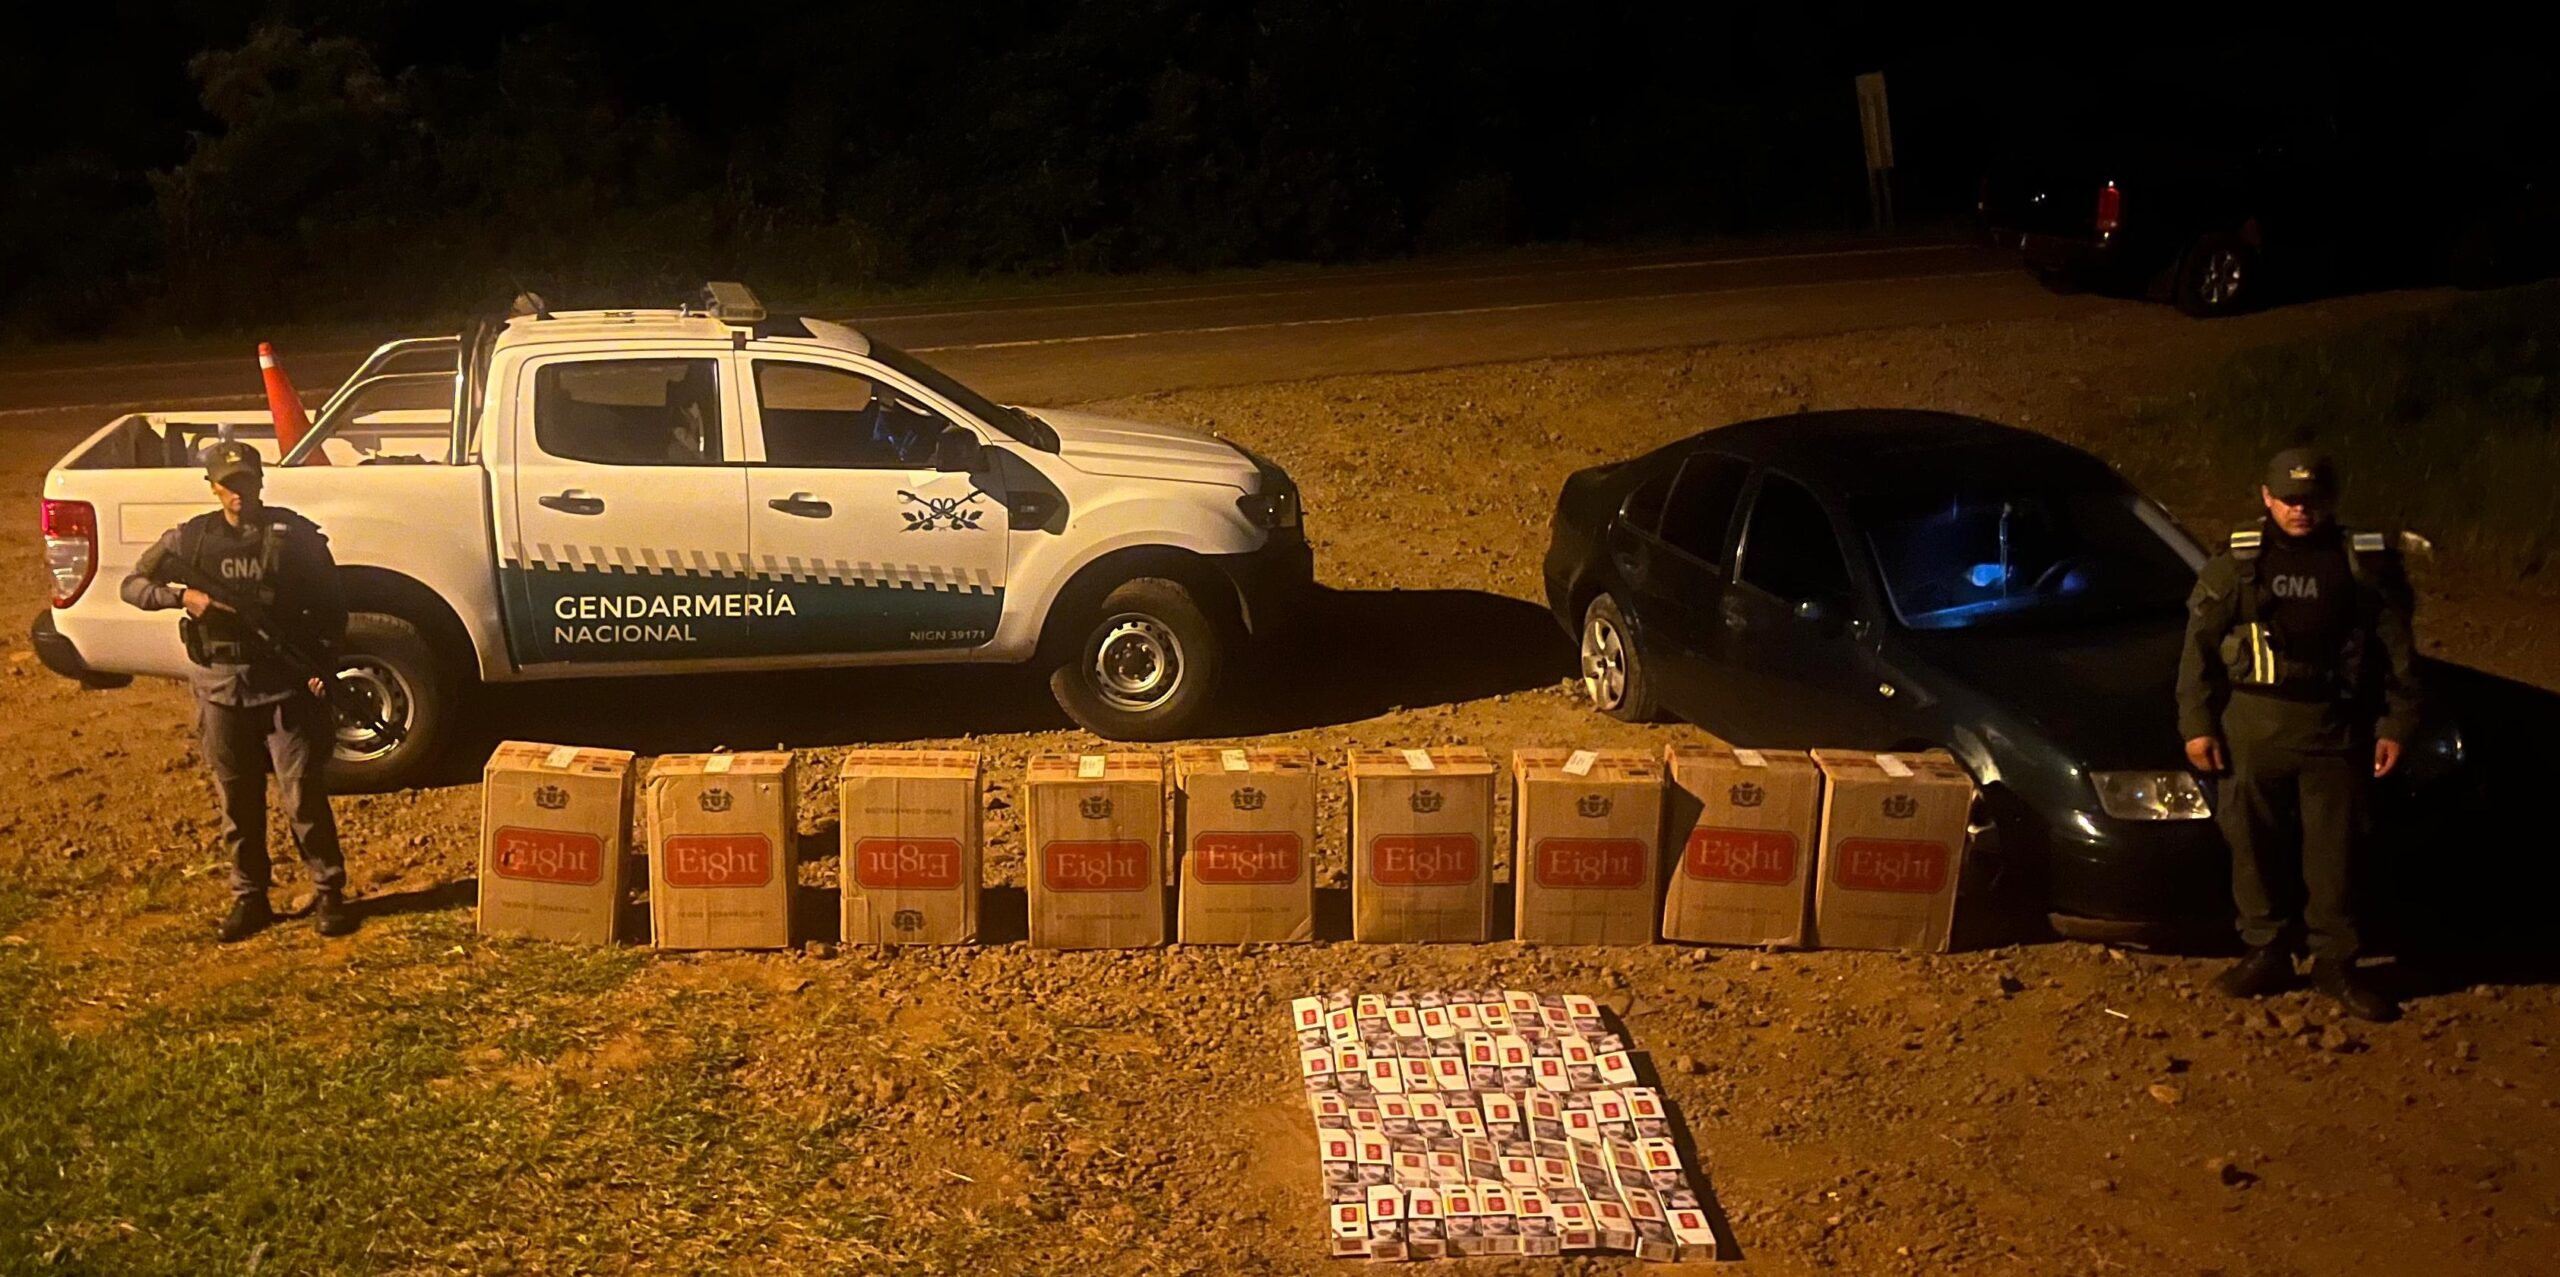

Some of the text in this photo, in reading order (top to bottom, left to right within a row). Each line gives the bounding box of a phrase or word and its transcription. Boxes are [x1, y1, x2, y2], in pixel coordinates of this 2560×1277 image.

[221, 558, 263, 580] GNA
[2272, 574, 2319, 598] GNA
[554, 588, 797, 621] GENDARMERÍA
[554, 623, 697, 644] NACIONAL
[909, 629, 986, 641] NIGN 39171
[504, 838, 588, 878] Eight
[676, 846, 760, 881] Eight
[868, 843, 949, 878] Eight
[1056, 851, 1136, 886] Eight
[1207, 842, 1289, 877] Eight
[1385, 845, 1466, 879] Eight
[1549, 848, 1634, 882] Eight
[1700, 839, 1783, 876] Eight
[1852, 850, 1934, 883] Eight
